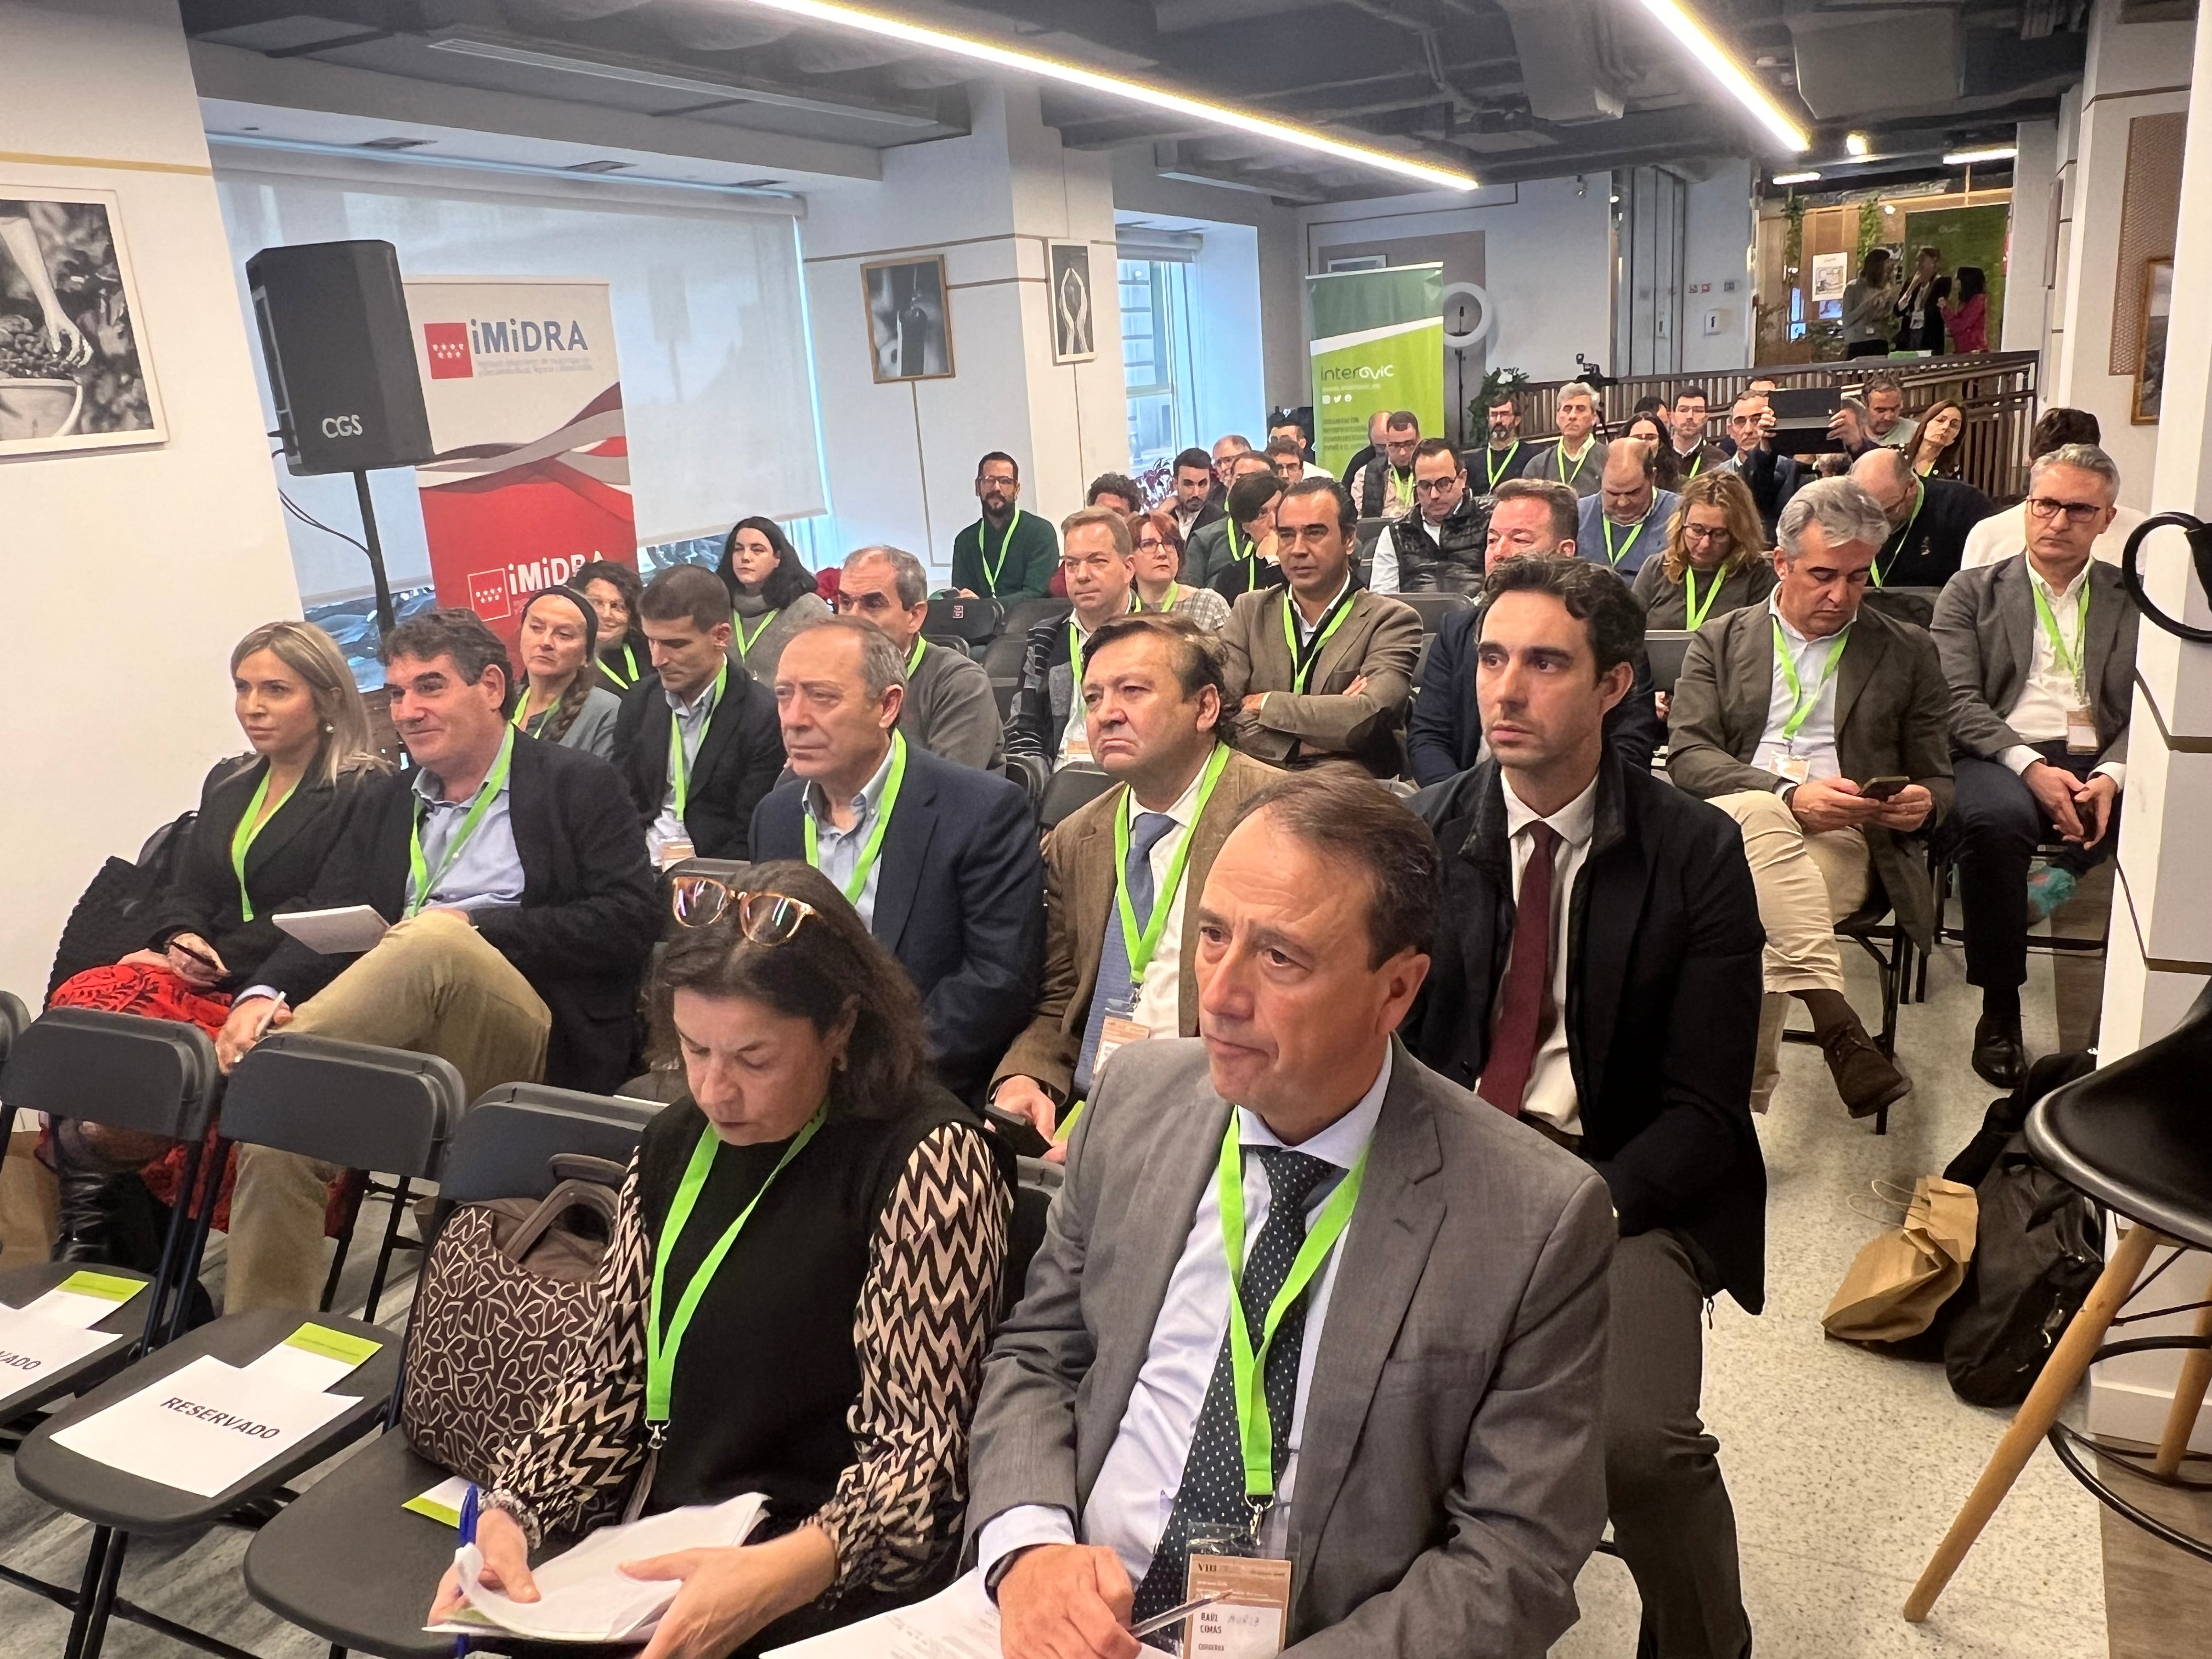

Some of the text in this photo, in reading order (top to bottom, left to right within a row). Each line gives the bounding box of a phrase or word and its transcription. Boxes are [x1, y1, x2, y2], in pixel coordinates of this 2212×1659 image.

[471, 318, 589, 354] iMiDRA
[322, 414, 363, 438] CGS
[160, 1397, 280, 1438] RESERVADO
